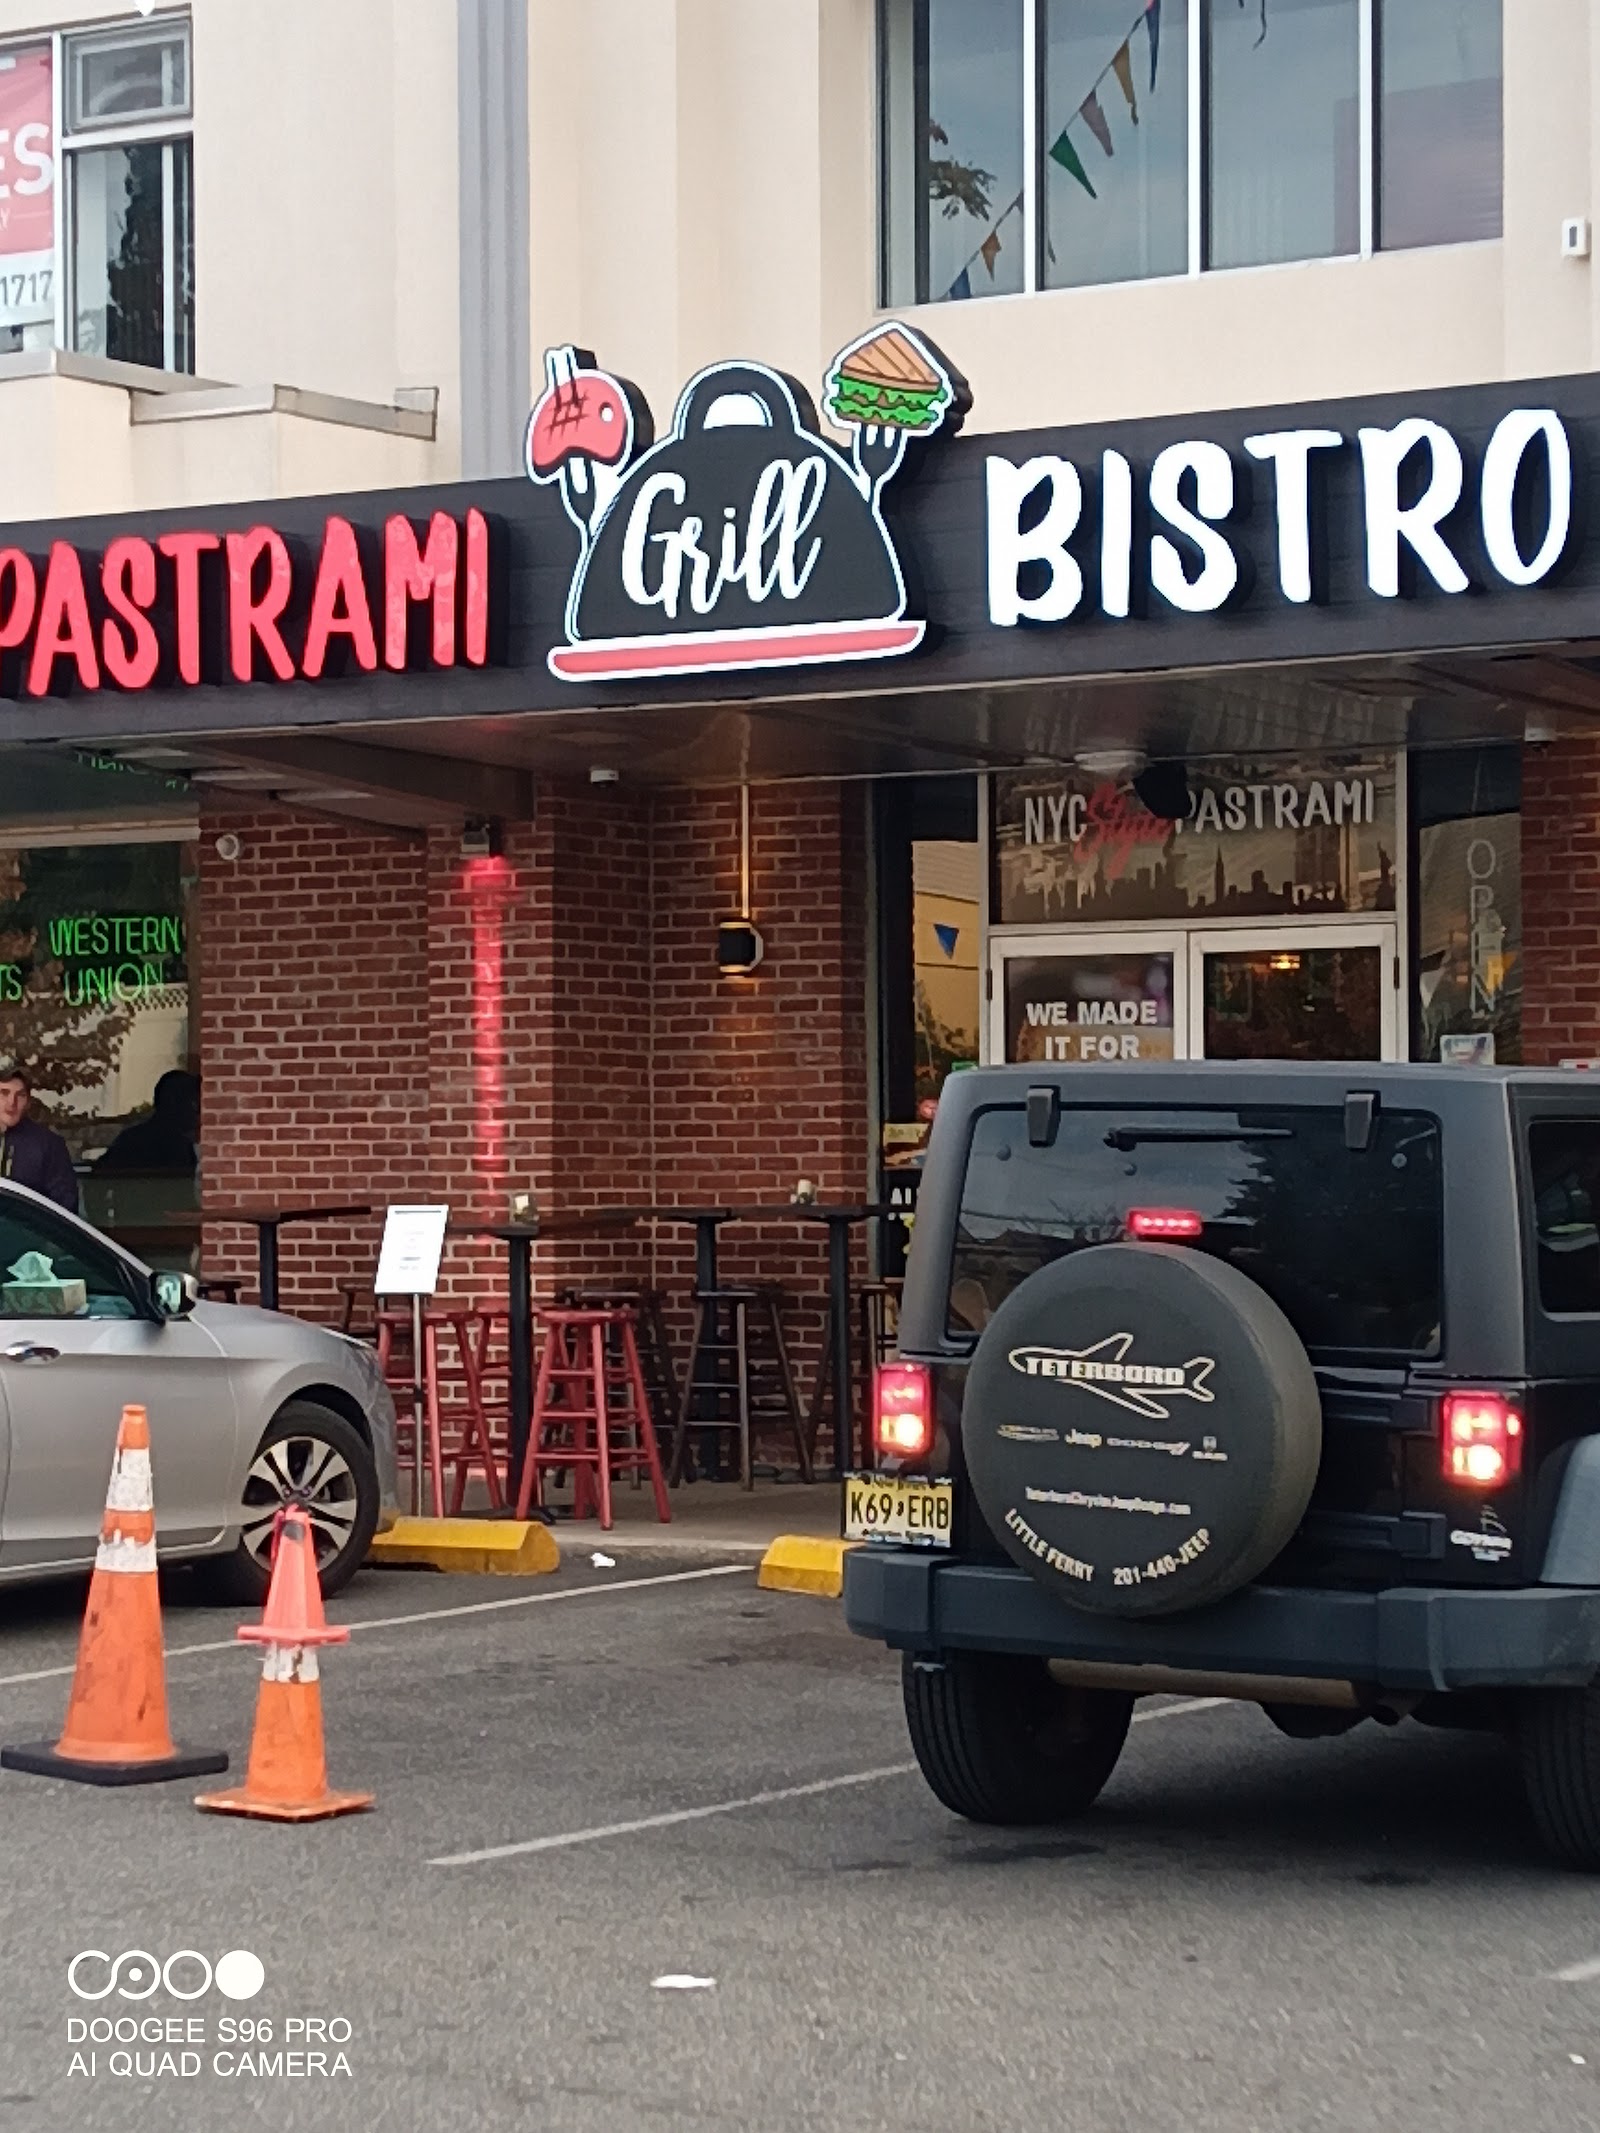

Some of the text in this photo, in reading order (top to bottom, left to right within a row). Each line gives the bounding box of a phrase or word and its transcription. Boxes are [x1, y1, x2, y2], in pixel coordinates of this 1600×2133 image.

[621, 455, 827, 618] Grill
[985, 408, 1571, 627] BISTRO
[0, 506, 489, 697] PASTRAMI
[1024, 793, 1088, 845] NYC
[50, 916, 181, 956] WESTERN
[64, 961, 165, 1007] UNION
[1026, 1000, 1158, 1027] WE MADE
[1045, 1034, 1140, 1060] IT FOR
